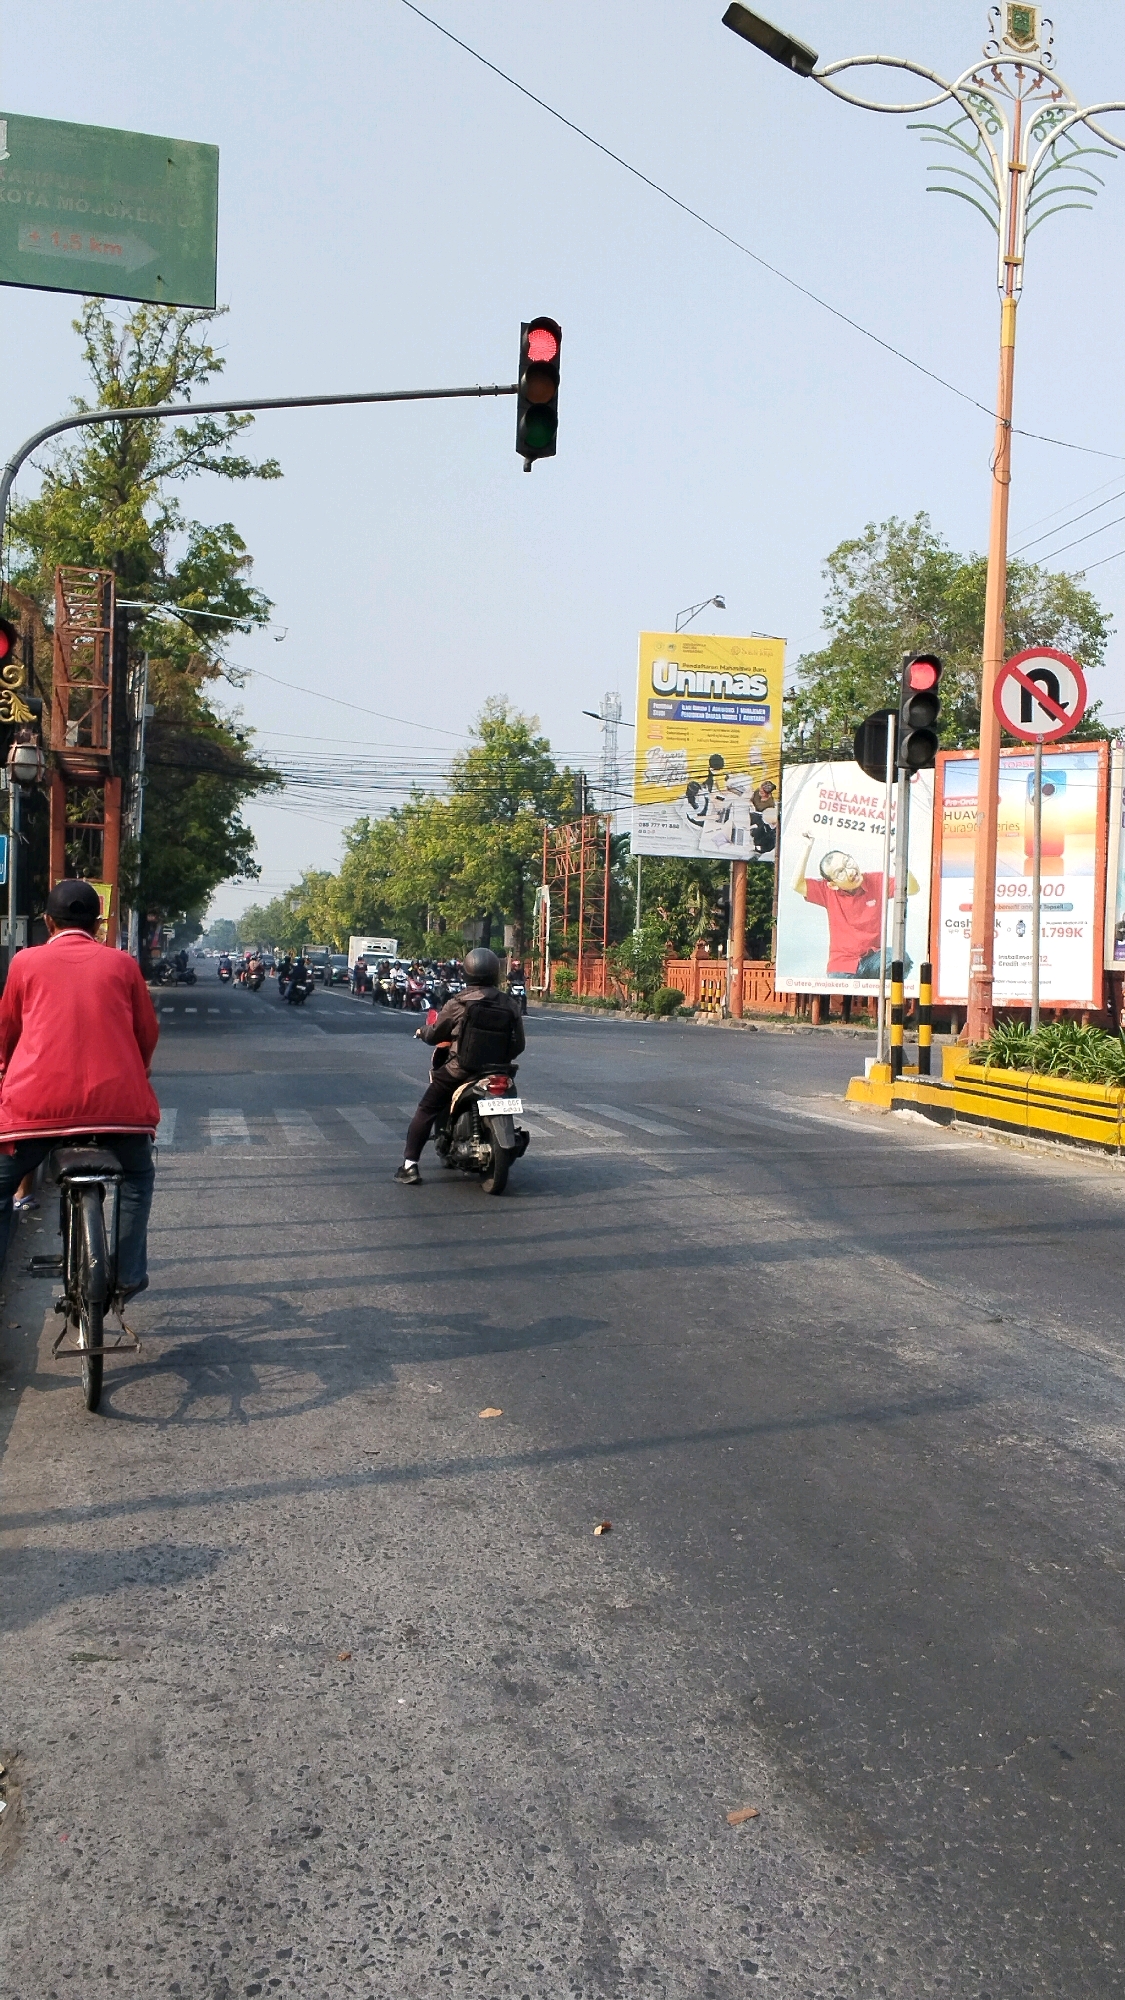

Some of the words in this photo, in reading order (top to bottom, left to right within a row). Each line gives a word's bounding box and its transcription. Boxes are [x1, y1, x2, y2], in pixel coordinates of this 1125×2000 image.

[58, 195, 191, 228] MOJOKERO
[51, 231, 82, 252] 1,5
[90, 237, 122, 255] km
[653, 662, 768, 700] Unimas
[1003, 759, 1048, 769] TOPSEL
[819, 788, 878, 808] REKLAME
[818, 799, 896, 822] DISEWAKAN
[813, 813, 834, 826] 081
[836, 818, 866, 832] 5522
[997, 820, 1020, 832] eries
[945, 918, 1002, 928] Cashk
[1041, 927, 1083, 938] 1.799K
